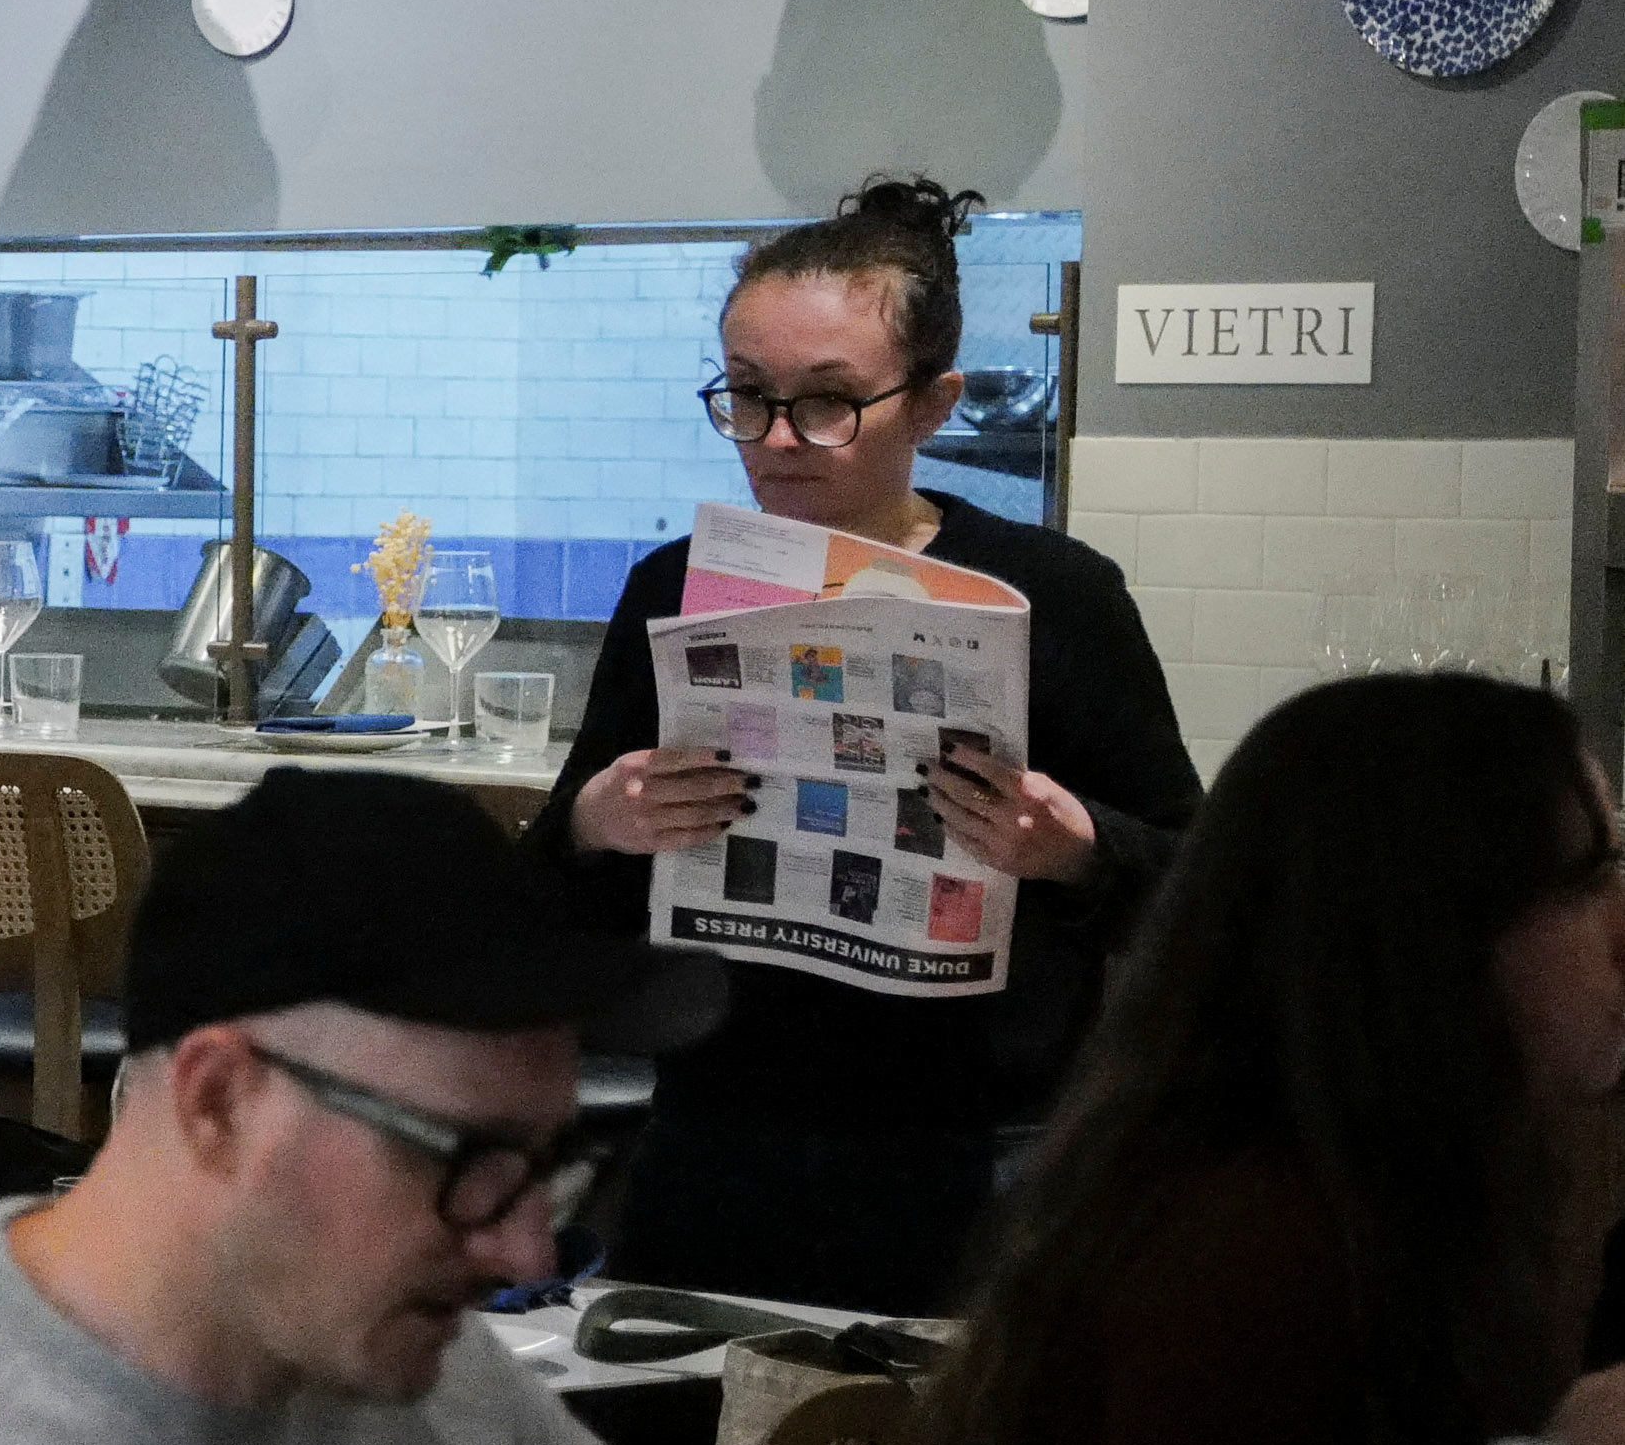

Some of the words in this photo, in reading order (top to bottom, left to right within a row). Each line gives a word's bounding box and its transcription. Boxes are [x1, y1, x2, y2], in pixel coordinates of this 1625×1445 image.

[1135, 306, 1356, 356] VIETRI
[695, 917, 767, 939] PRESS
[775, 926, 901, 970] UNIVERSITY
[908, 957, 970, 976] DUKE
